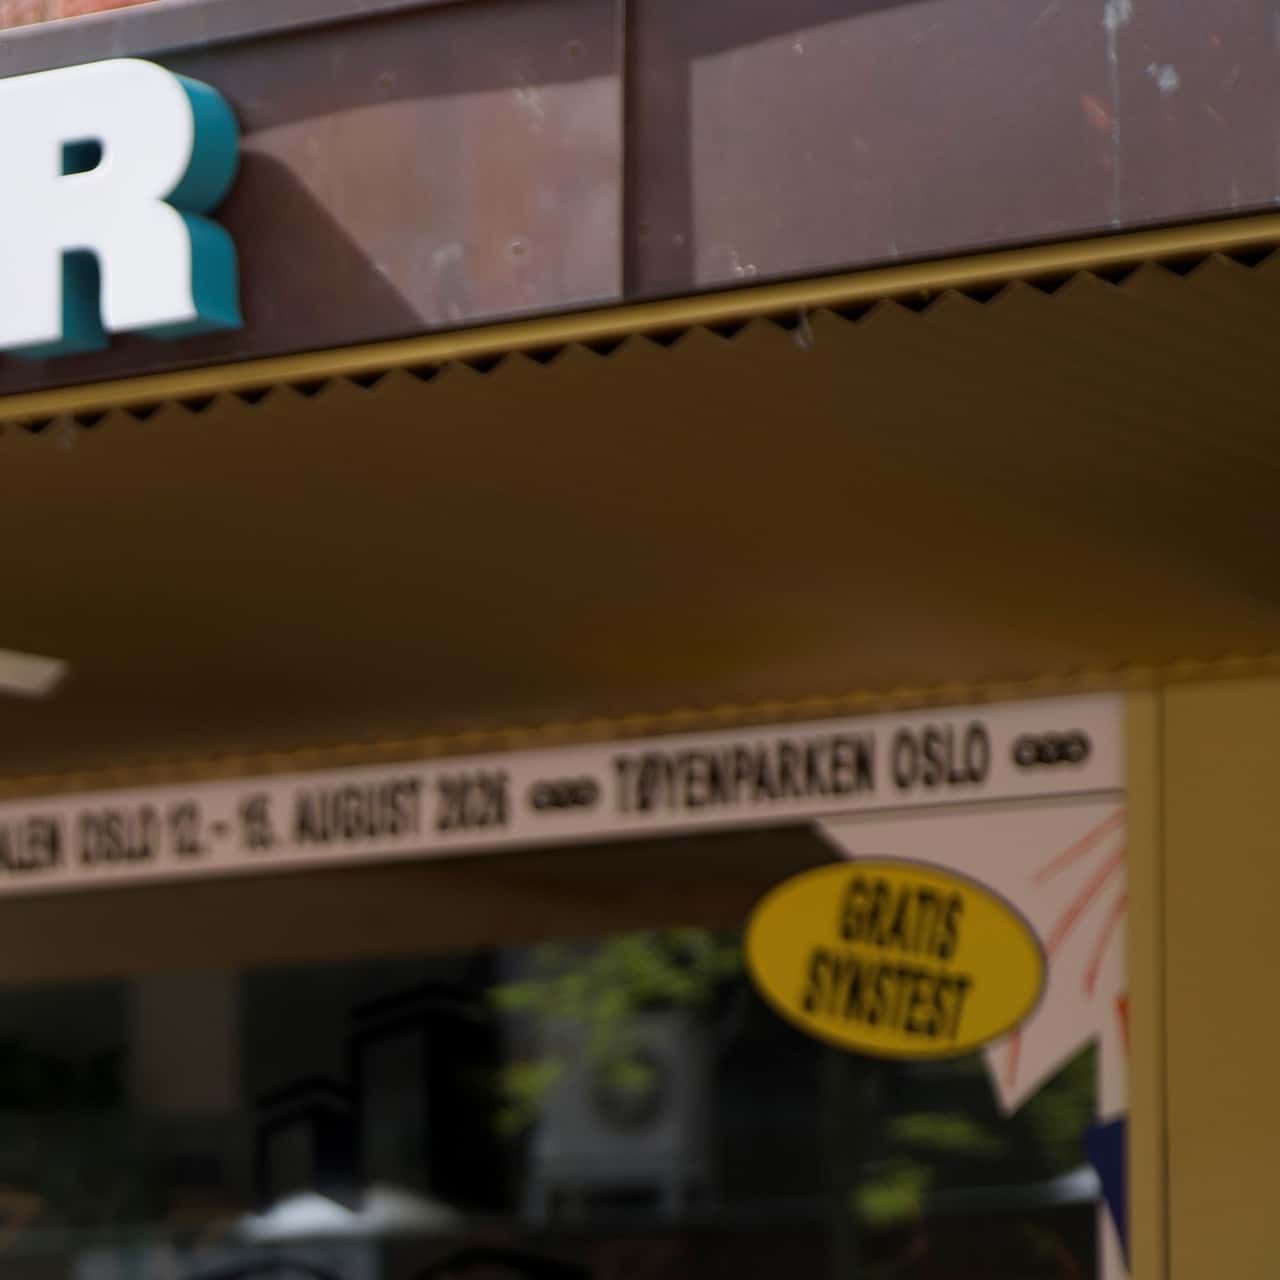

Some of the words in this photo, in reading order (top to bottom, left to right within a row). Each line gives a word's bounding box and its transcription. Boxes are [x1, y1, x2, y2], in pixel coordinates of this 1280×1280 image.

[78, 804, 155, 867] OSLO
[294, 777, 420, 846] AUGUST
[437, 767, 510, 834] 2026
[614, 731, 876, 816] TØYENPARKEN
[891, 720, 992, 791] OSLO
[837, 873, 964, 963] GRATIS
[801, 947, 972, 1041] SYNSTEST
